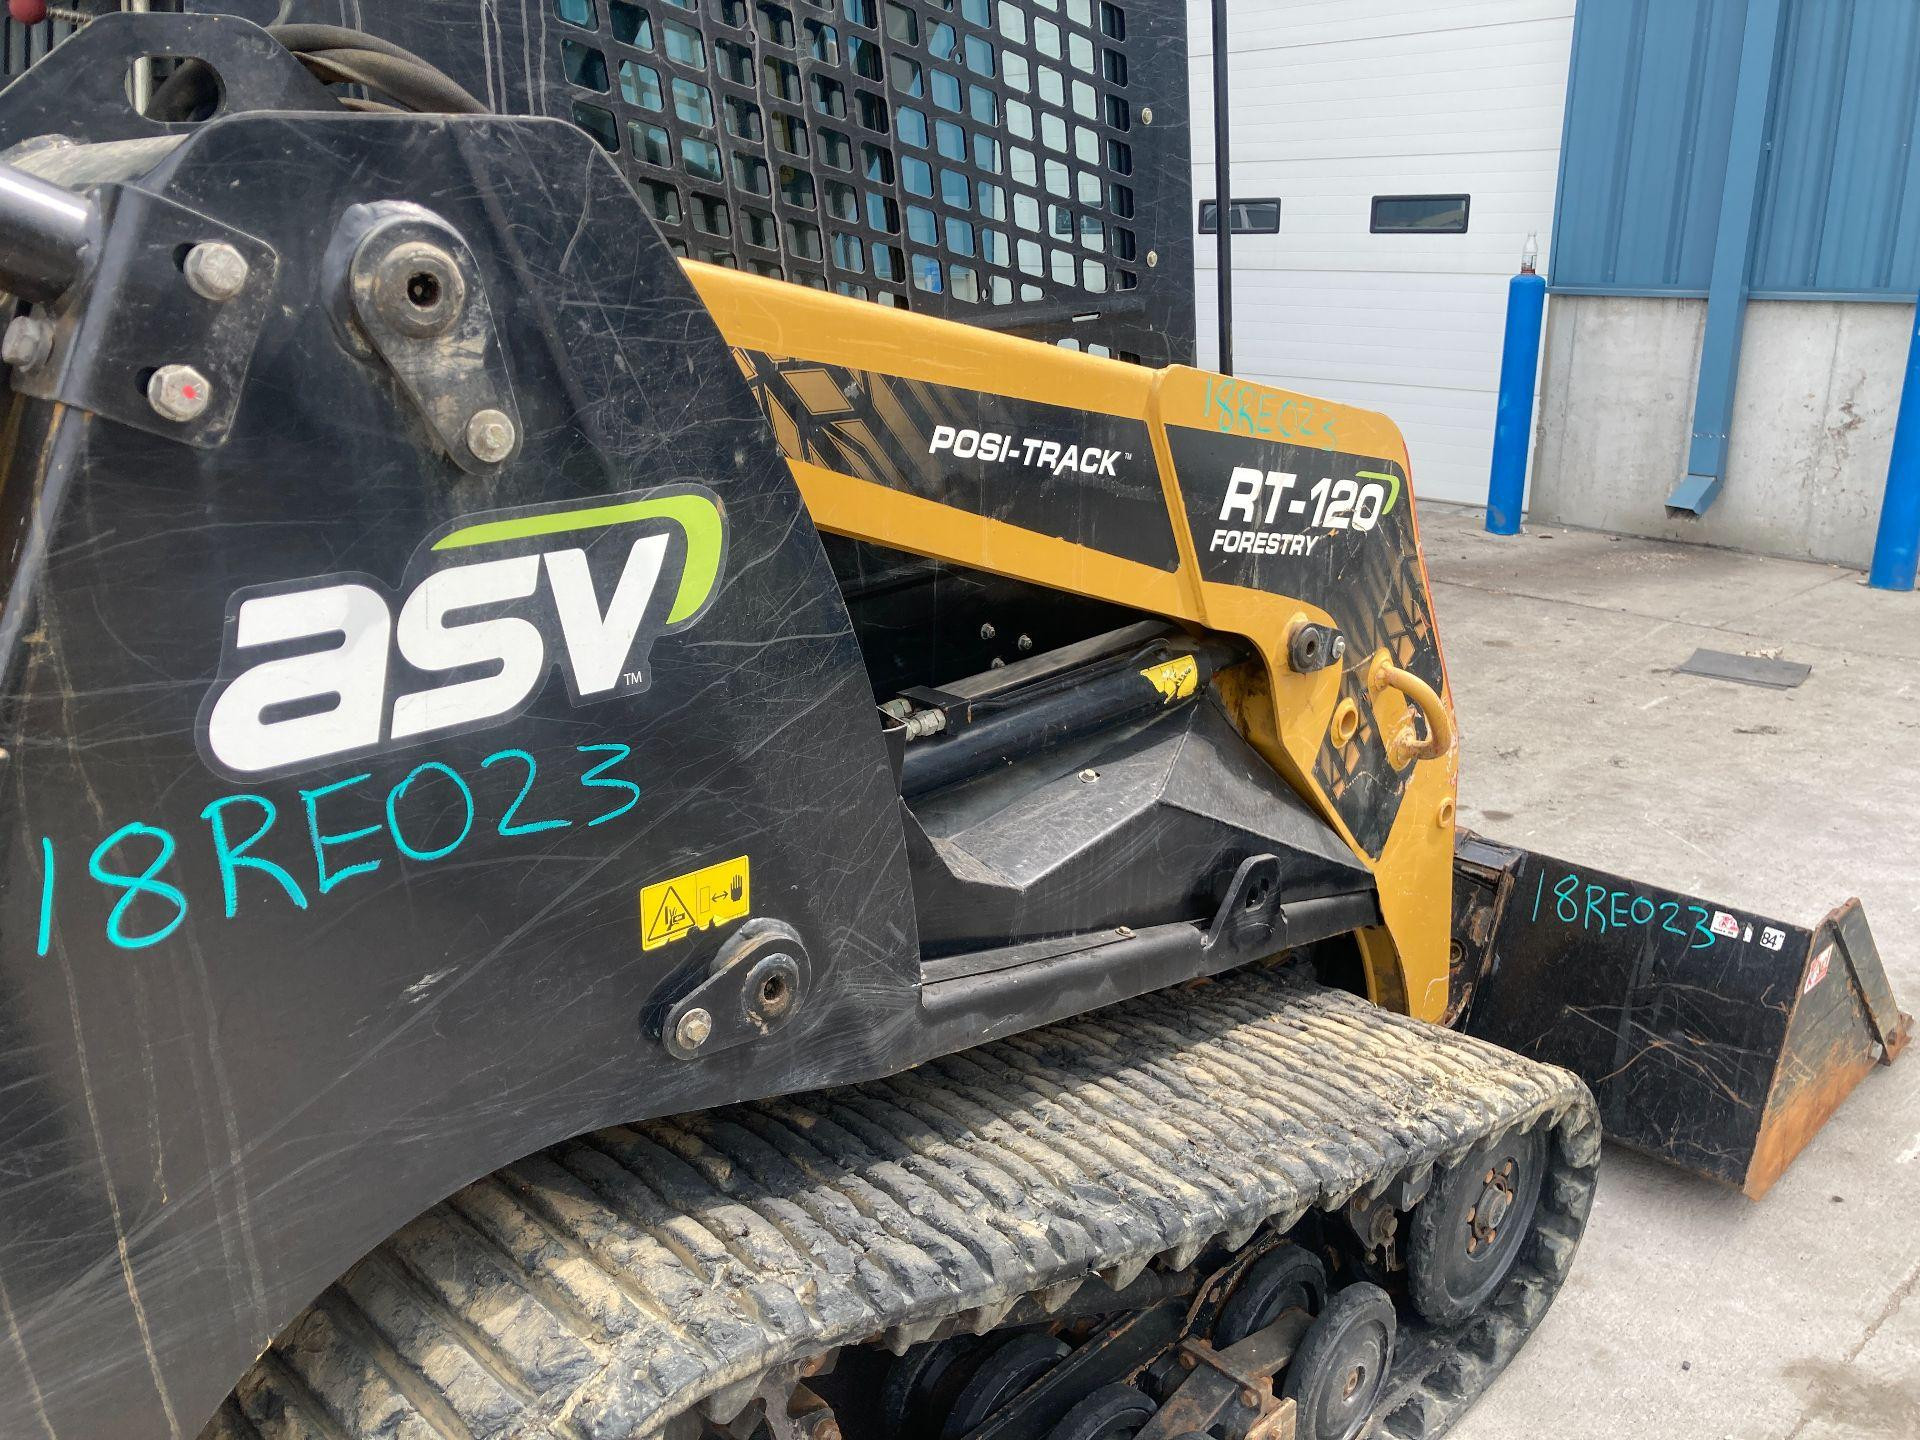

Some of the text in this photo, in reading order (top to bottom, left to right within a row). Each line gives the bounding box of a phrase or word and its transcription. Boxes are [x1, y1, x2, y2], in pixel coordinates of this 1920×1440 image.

[928, 425, 1121, 477] POSI-TRACK
[1218, 466, 1385, 532] RT-120
[1209, 529, 1320, 557] FORESTRY
